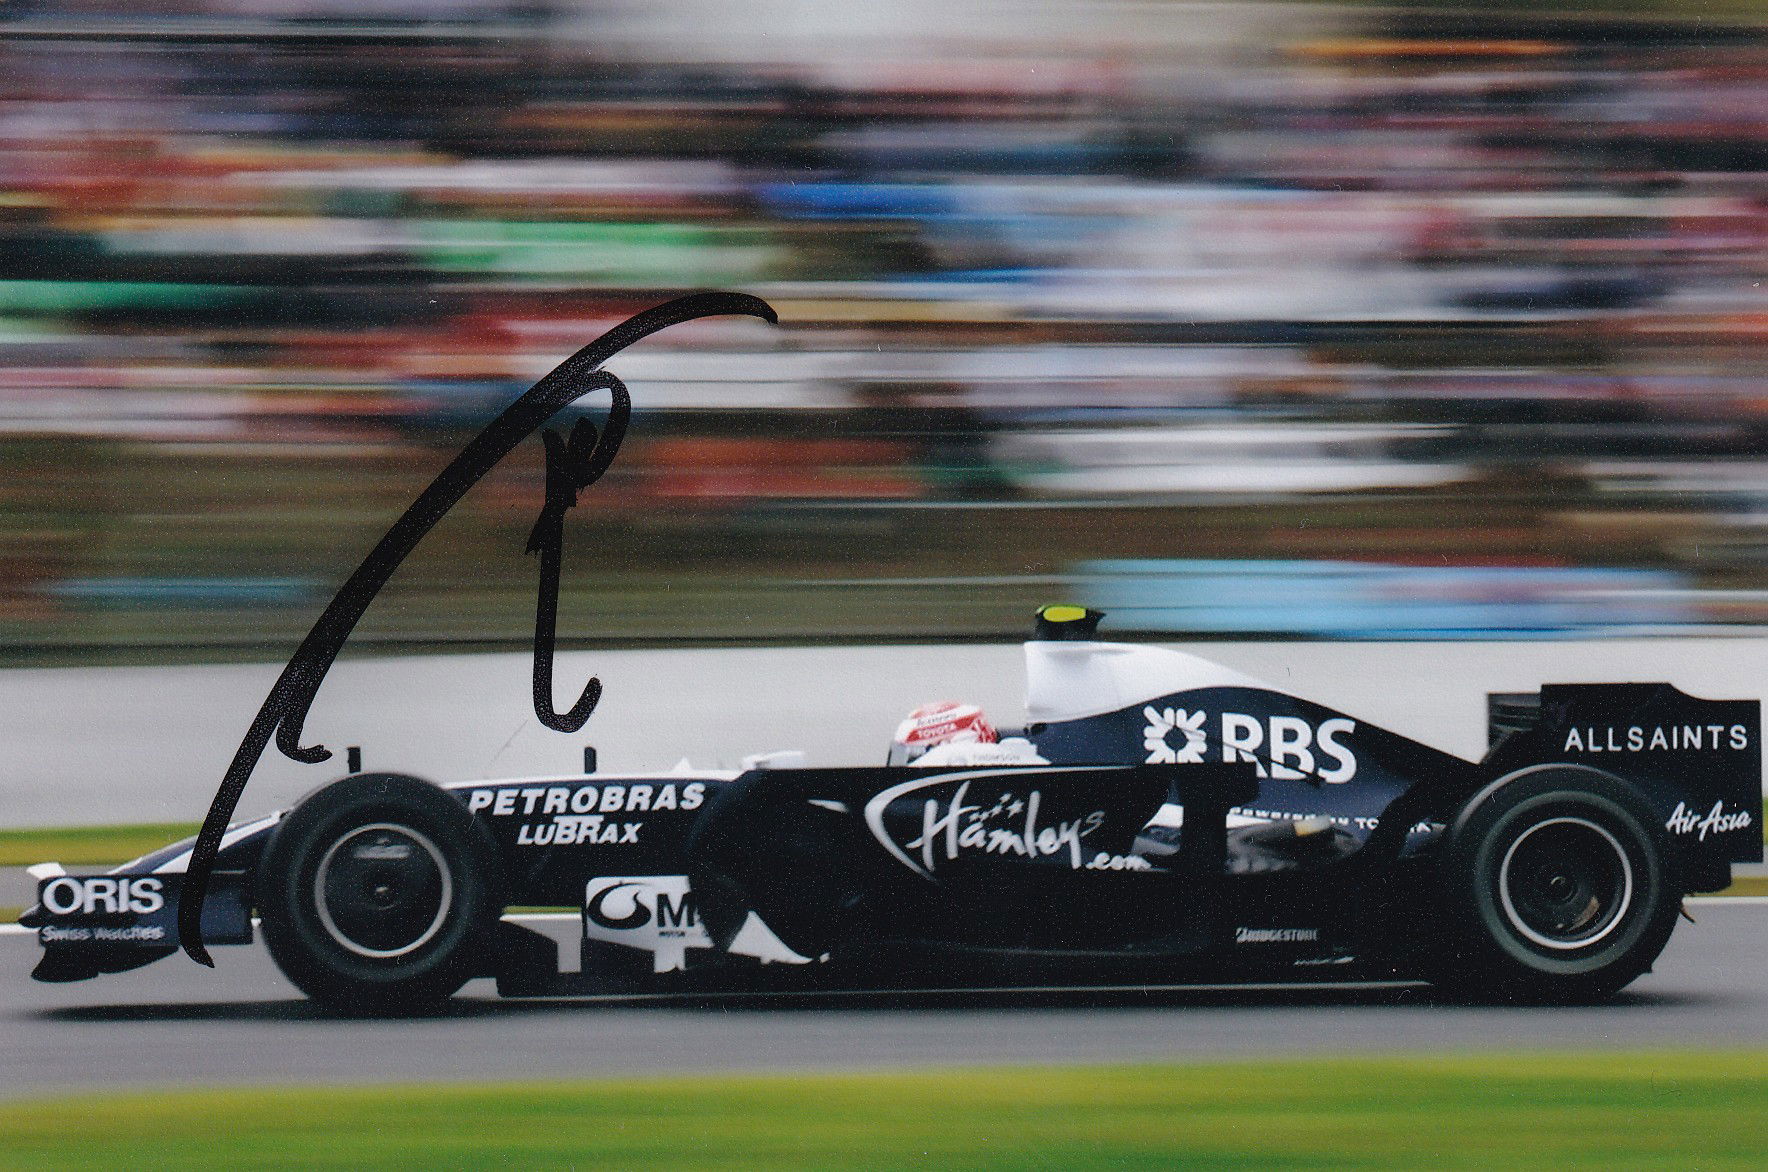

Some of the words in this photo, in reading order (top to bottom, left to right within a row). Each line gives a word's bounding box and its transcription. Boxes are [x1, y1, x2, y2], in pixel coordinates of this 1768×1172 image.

[1222, 711, 1357, 785] RBS
[1564, 724, 1749, 753] ALLSAINTS
[468, 783, 706, 816] PETROBRAS
[517, 814, 643, 845] LUBRAX
[42, 877, 165, 915] ORIS
